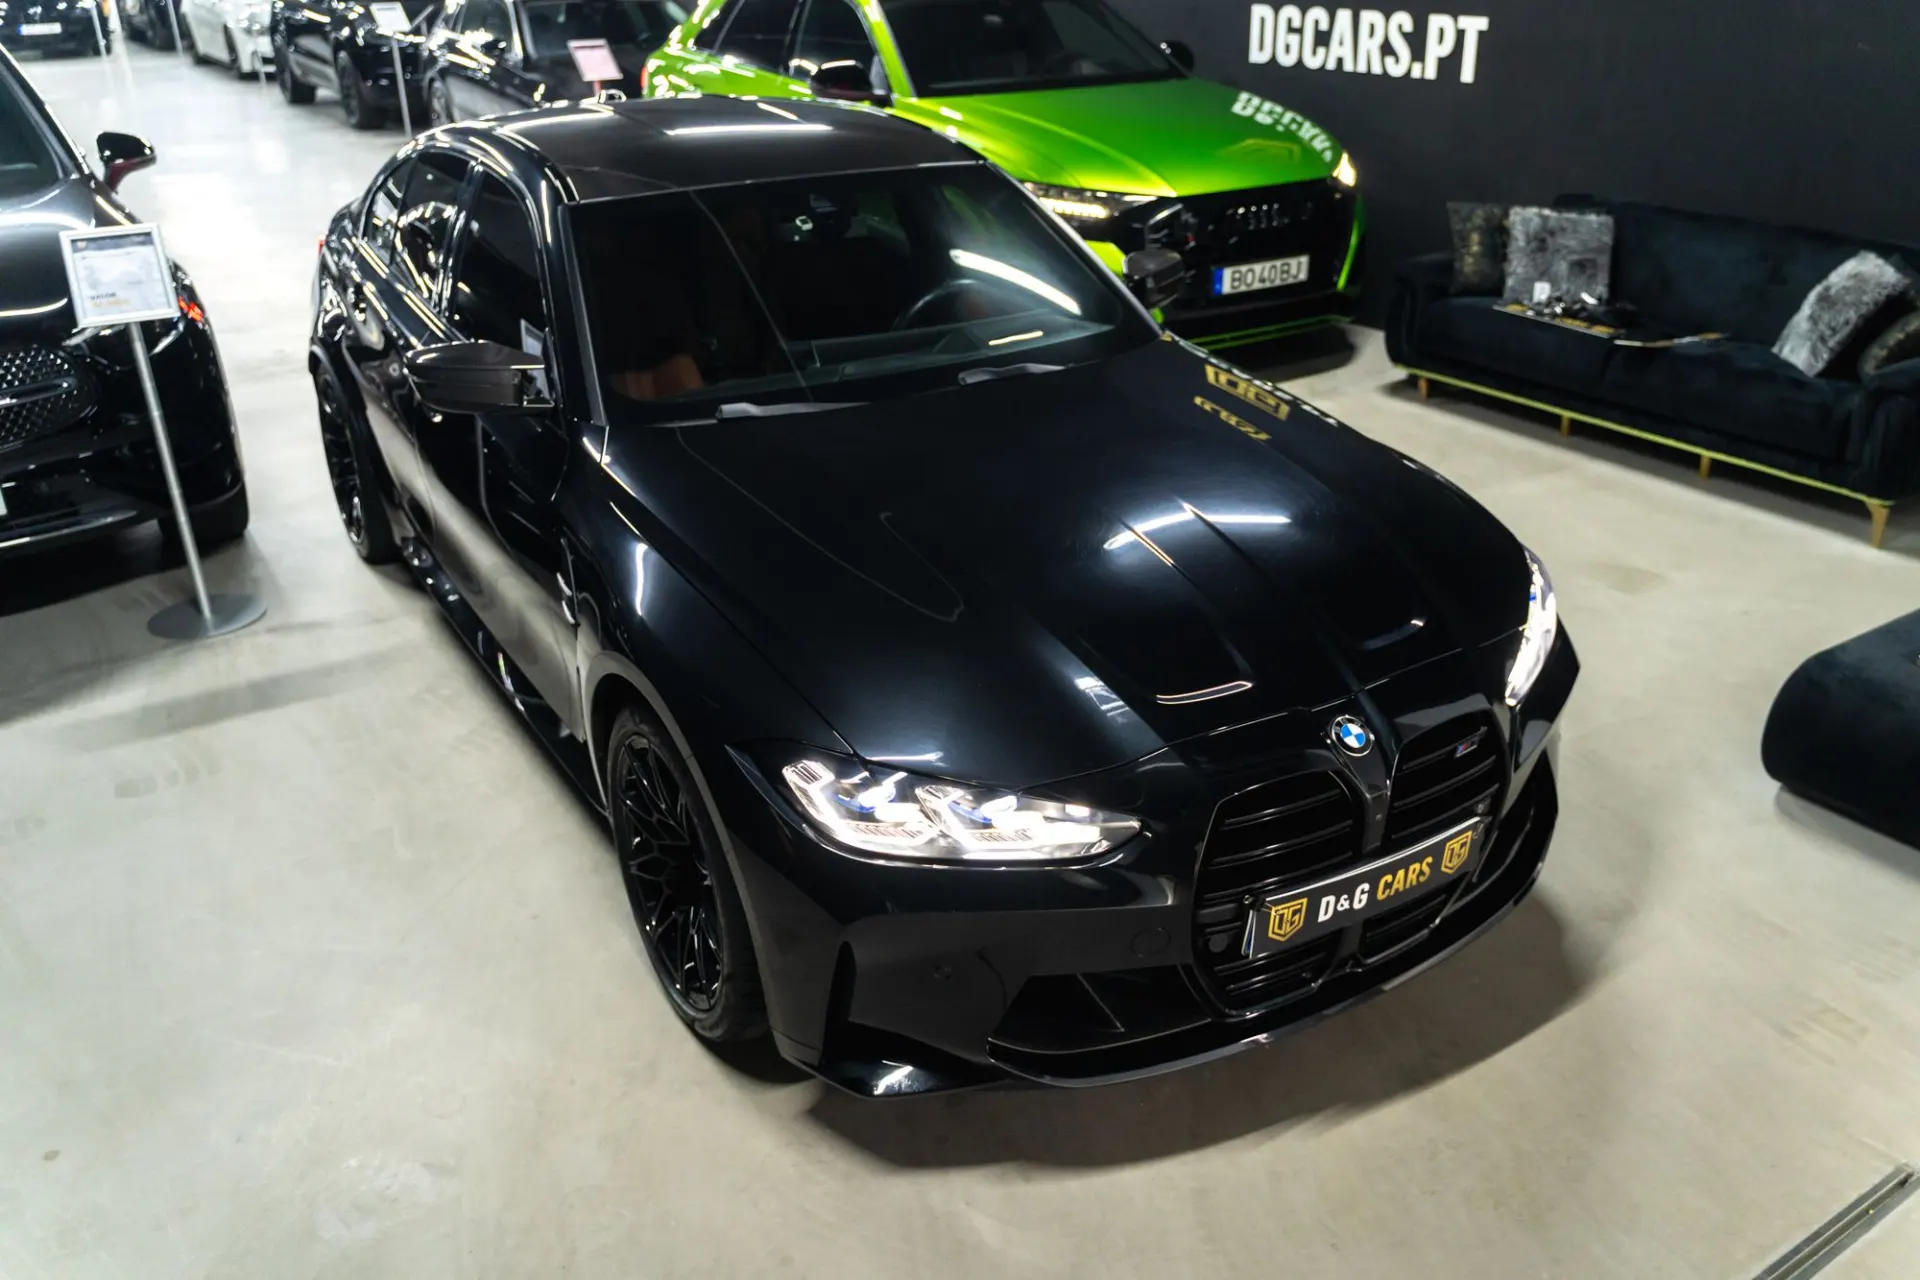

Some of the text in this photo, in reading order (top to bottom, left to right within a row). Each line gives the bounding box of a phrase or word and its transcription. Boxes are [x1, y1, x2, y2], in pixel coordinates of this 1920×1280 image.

[1248, 3, 1490, 84] DGCARS.PT
[1317, 882, 1370, 923] D&G
[1376, 855, 1434, 901] CARS
